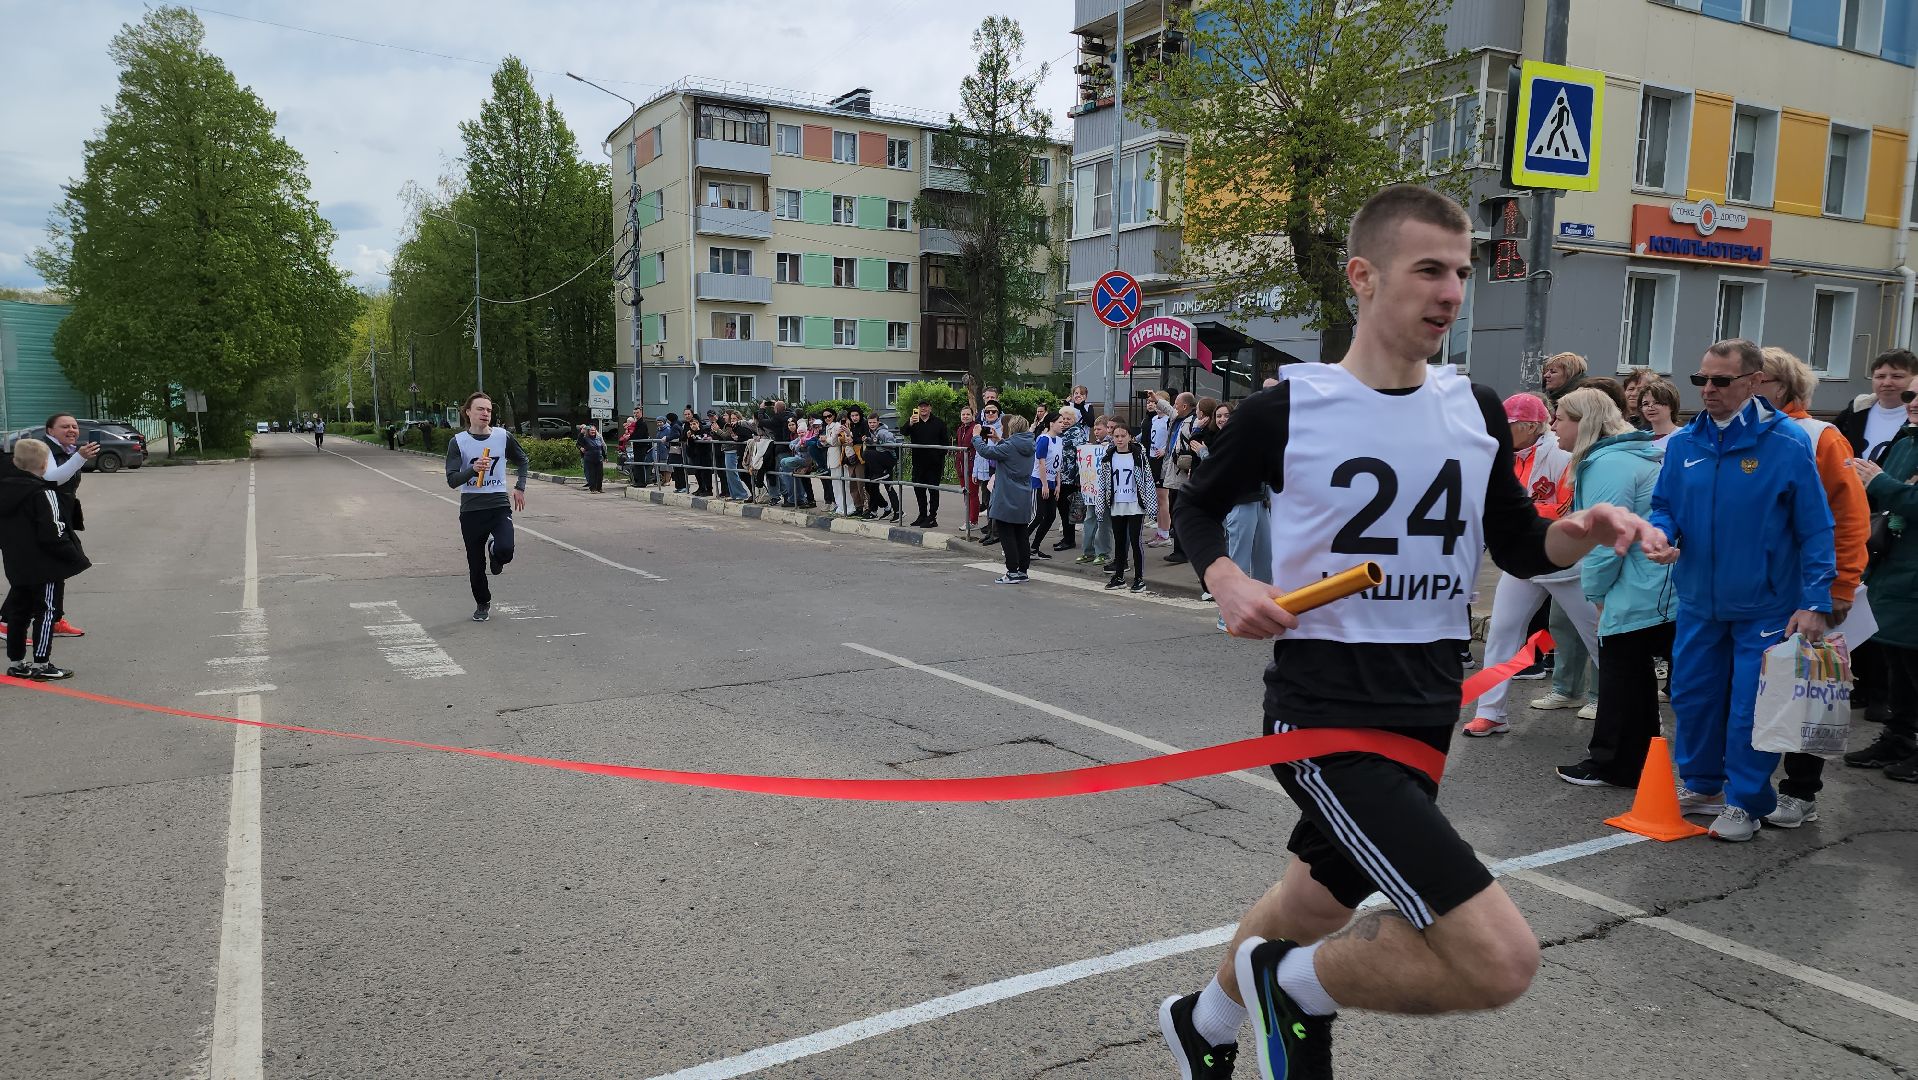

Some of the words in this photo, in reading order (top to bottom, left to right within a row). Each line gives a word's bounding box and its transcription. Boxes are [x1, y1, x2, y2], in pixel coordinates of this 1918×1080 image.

[1649, 235, 1763, 262] КОМПЬЮТЕРЫ
[1131, 322, 1187, 348] ПРЕМЬЕР
[1112, 468, 1133, 486] 17
[1330, 456, 1467, 556] 24
[1321, 571, 1465, 601] ШИРА
